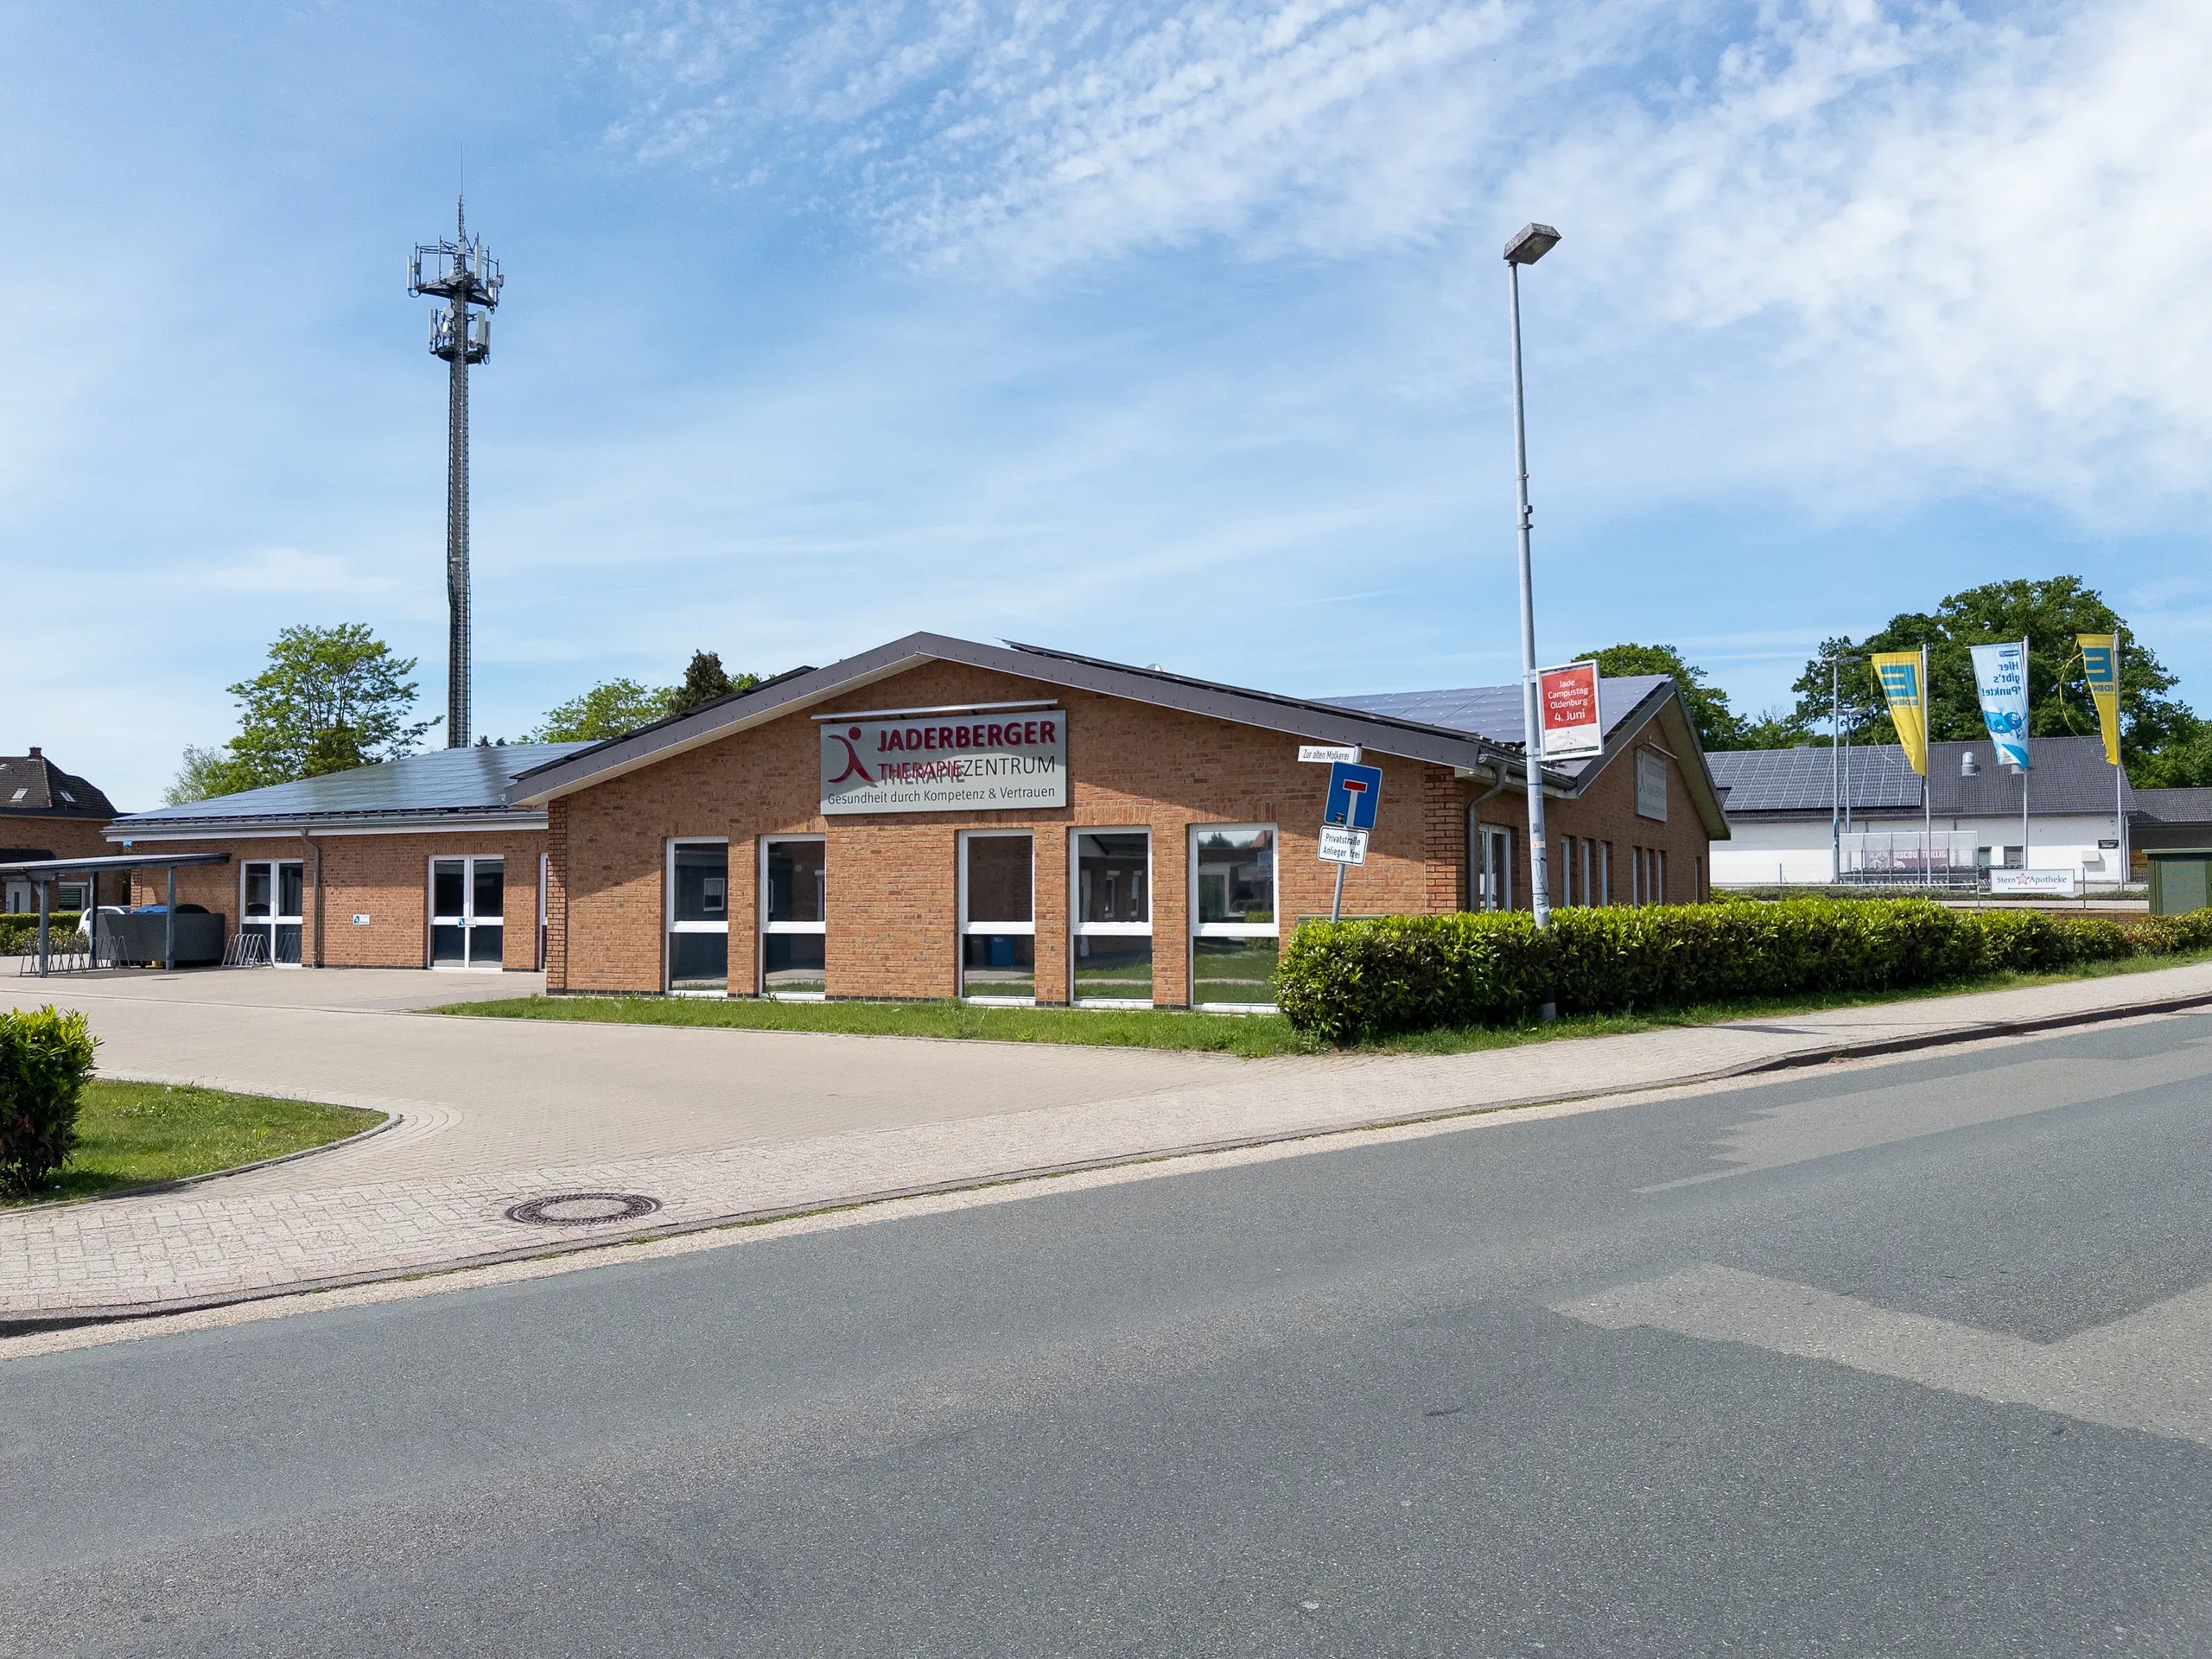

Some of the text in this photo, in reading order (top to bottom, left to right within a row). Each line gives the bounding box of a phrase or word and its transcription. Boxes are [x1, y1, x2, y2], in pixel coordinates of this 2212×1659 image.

[1559, 679, 1575, 689] Jade
[1548, 687, 1589, 699] Campustag
[1550, 698, 1588, 709] Oldenburg
[1554, 709, 1586, 722] 4. Juni
[877, 721, 1056, 752] JADERBERGER
[1303, 748, 1350, 760] Zur alten Molkerei
[877, 755, 1056, 780] THERAPIEZENTRUM
[827, 786, 1055, 804] Gesundheit durch Kompetenz & Vertrauen
[1325, 832, 1361, 846] Privatstraße
[1322, 845, 1361, 859] Anlieger frei
[2029, 874, 2067, 886] Apotheke
